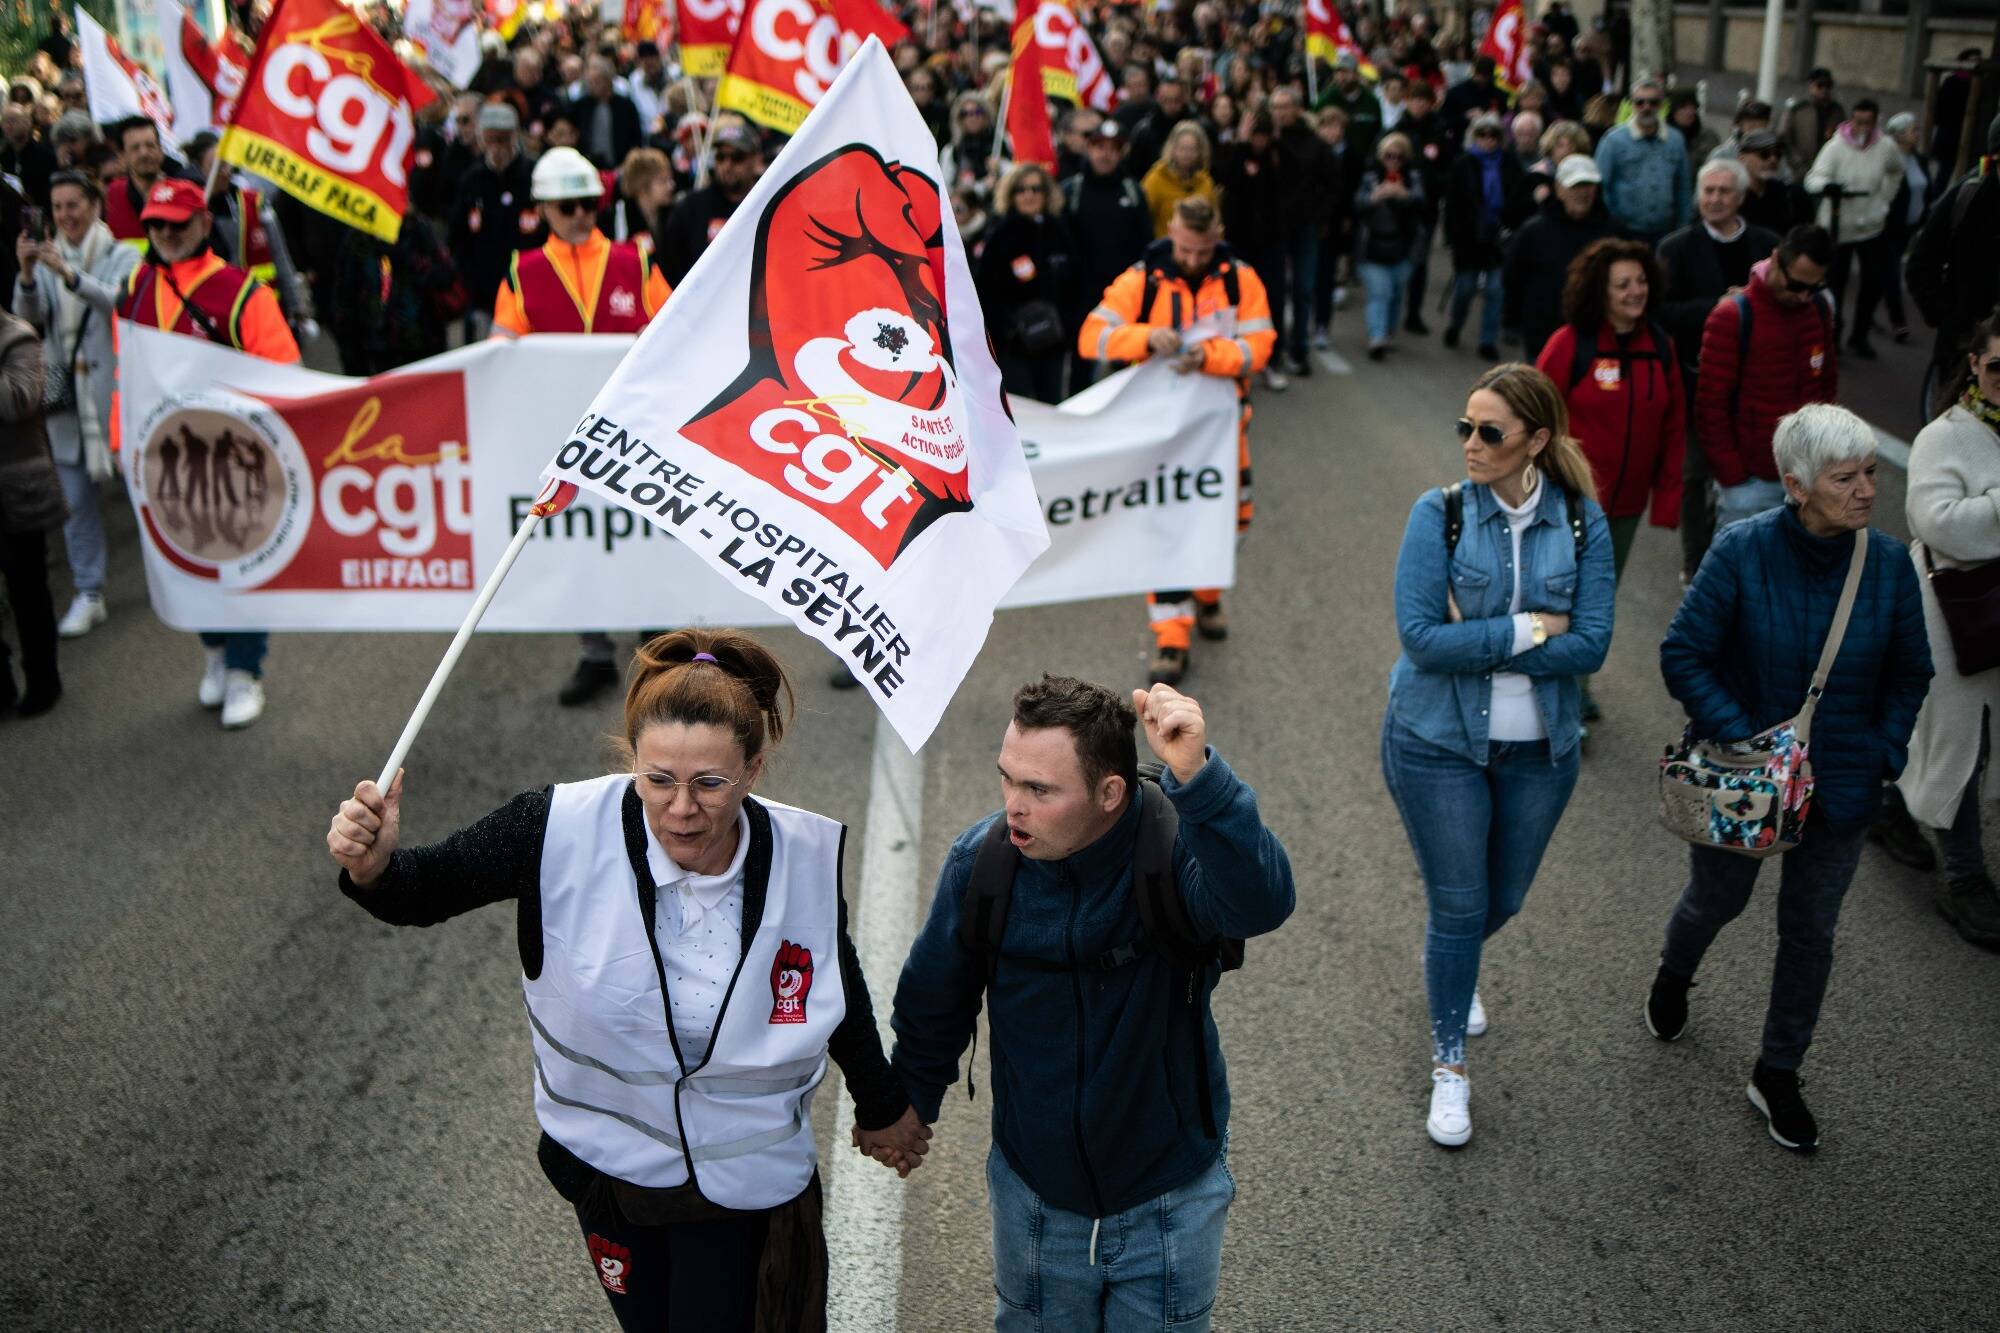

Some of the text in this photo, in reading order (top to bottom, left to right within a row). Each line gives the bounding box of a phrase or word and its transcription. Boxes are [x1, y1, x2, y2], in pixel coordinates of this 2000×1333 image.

[244, 142, 378, 223] URSSAF PACA
[901, 432, 943, 458] ACTION
[911, 415, 946, 435] SANTÉ
[320, 441, 473, 557] cgt
[749, 407, 915, 531] cgt
[1037, 463, 1224, 526] etraite
[341, 557, 469, 587] EIFFAGE
[556, 440, 699, 526] OULON
[718, 536, 776, 588] LA
[781, 577, 905, 699] SEYNE
[576, 413, 911, 667] CENTRE HOSPITALIER
[777, 996, 800, 1013] cgt
